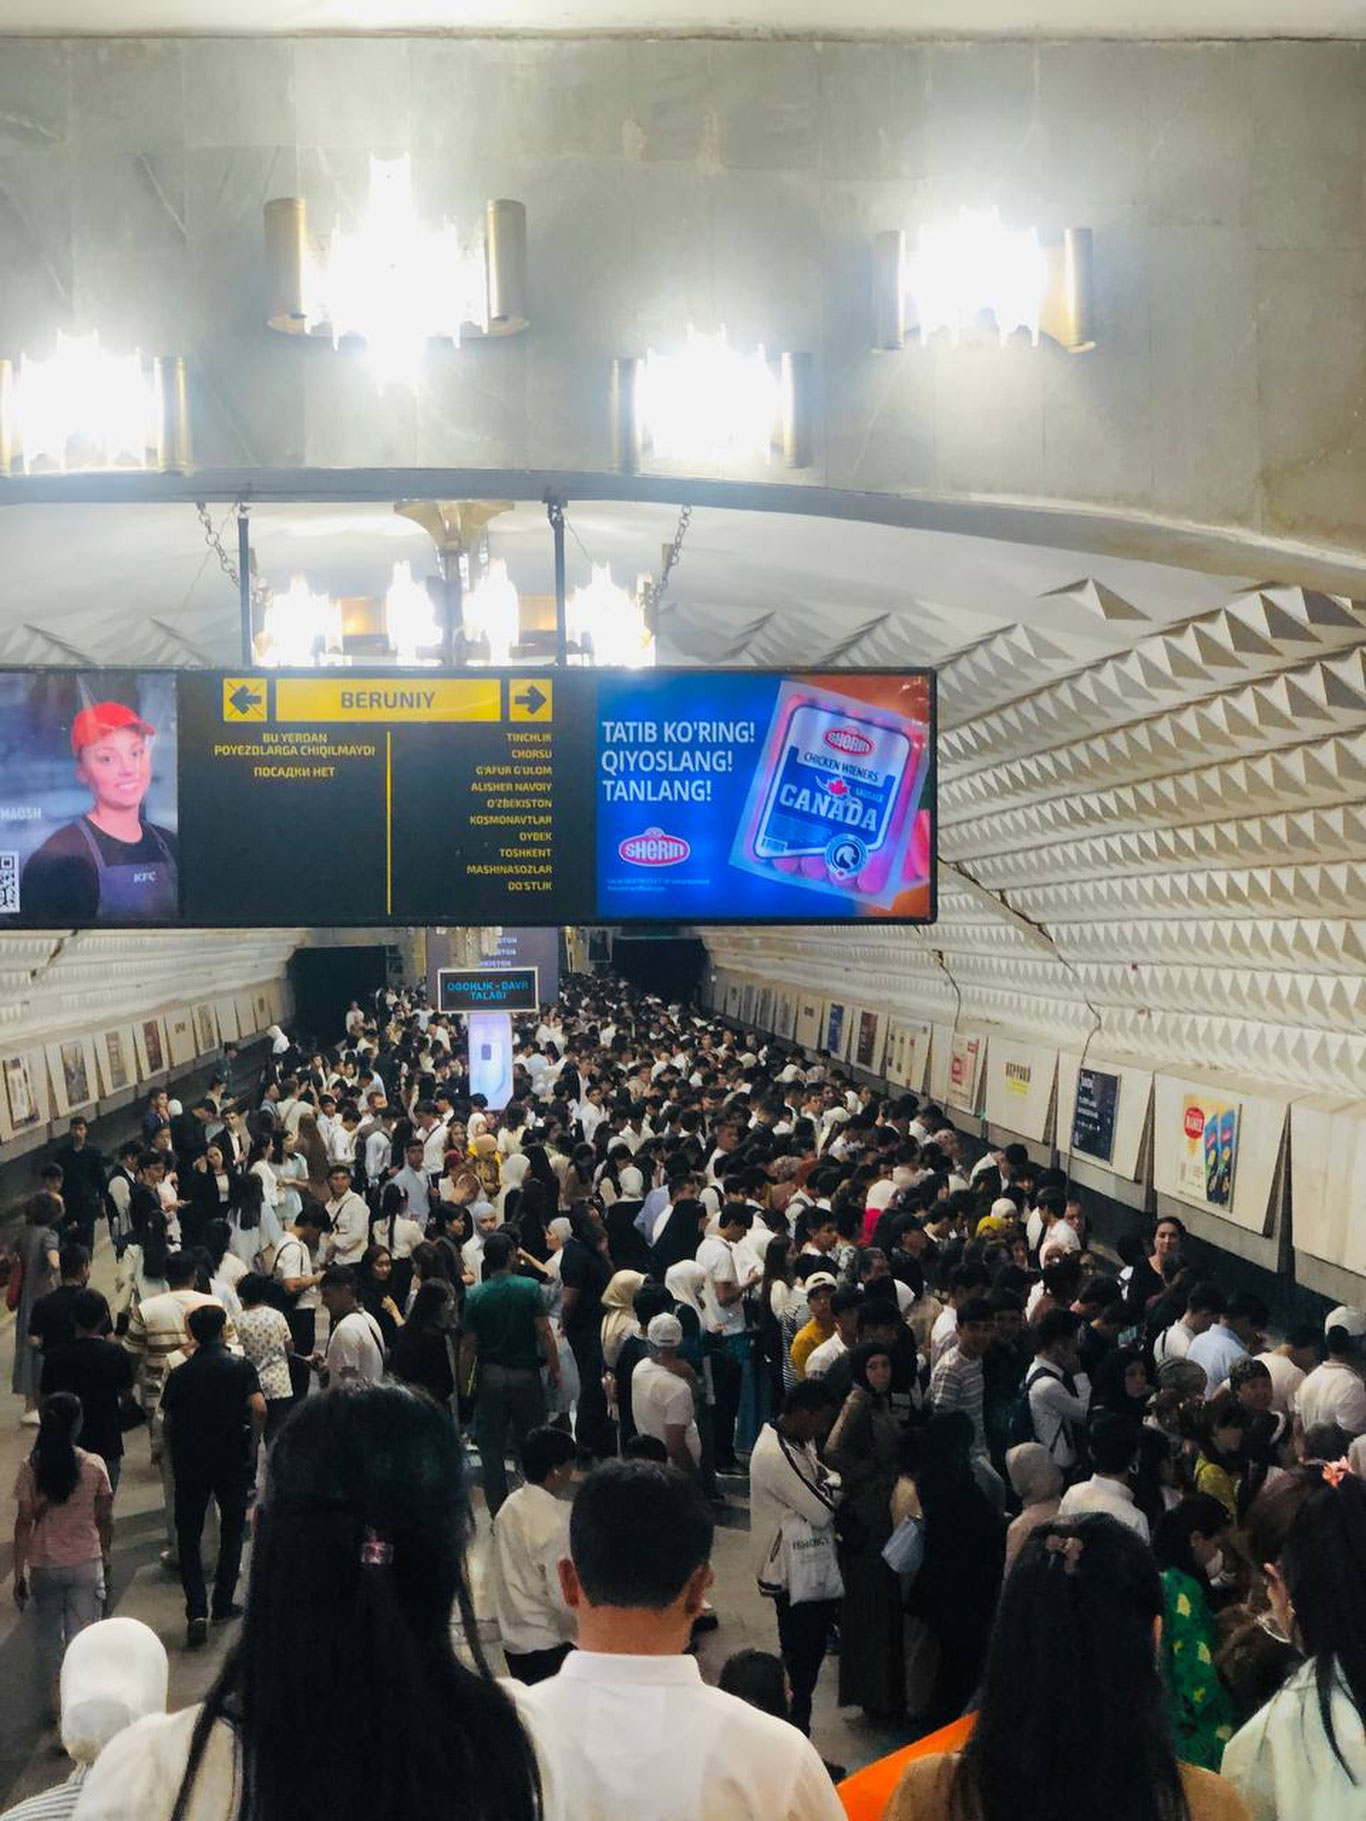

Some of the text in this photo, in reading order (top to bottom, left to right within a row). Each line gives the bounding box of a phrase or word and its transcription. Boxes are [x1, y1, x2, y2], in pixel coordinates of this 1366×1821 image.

[341, 691, 436, 709] BERUNIY
[262, 733, 328, 743] BU YERDAN
[602, 721, 755, 744] TATIB KO'RING!
[214, 745, 375, 758] POYEZDLARGA CHIQILMAYDI
[511, 749, 553, 759] CHORSU
[601, 750, 733, 776] QIYOSLANG!
[803, 751, 879, 783] CHICKEN WIENERS
[254, 766, 335, 779] ПОСАДКИ НЕТ
[471, 782, 552, 792] ALISHER NAVOIY
[602, 780, 712, 802] TANLANG!
[779, 783, 878, 832] CANADA
[469, 815, 553, 826] KOSMONAVTLAR
[519, 831, 553, 842] OYBEK
[500, 848, 552, 858] TOSHKENT
[466, 864, 553, 875] MASHINASOZLAR
[133, 870, 156, 884] KFC
